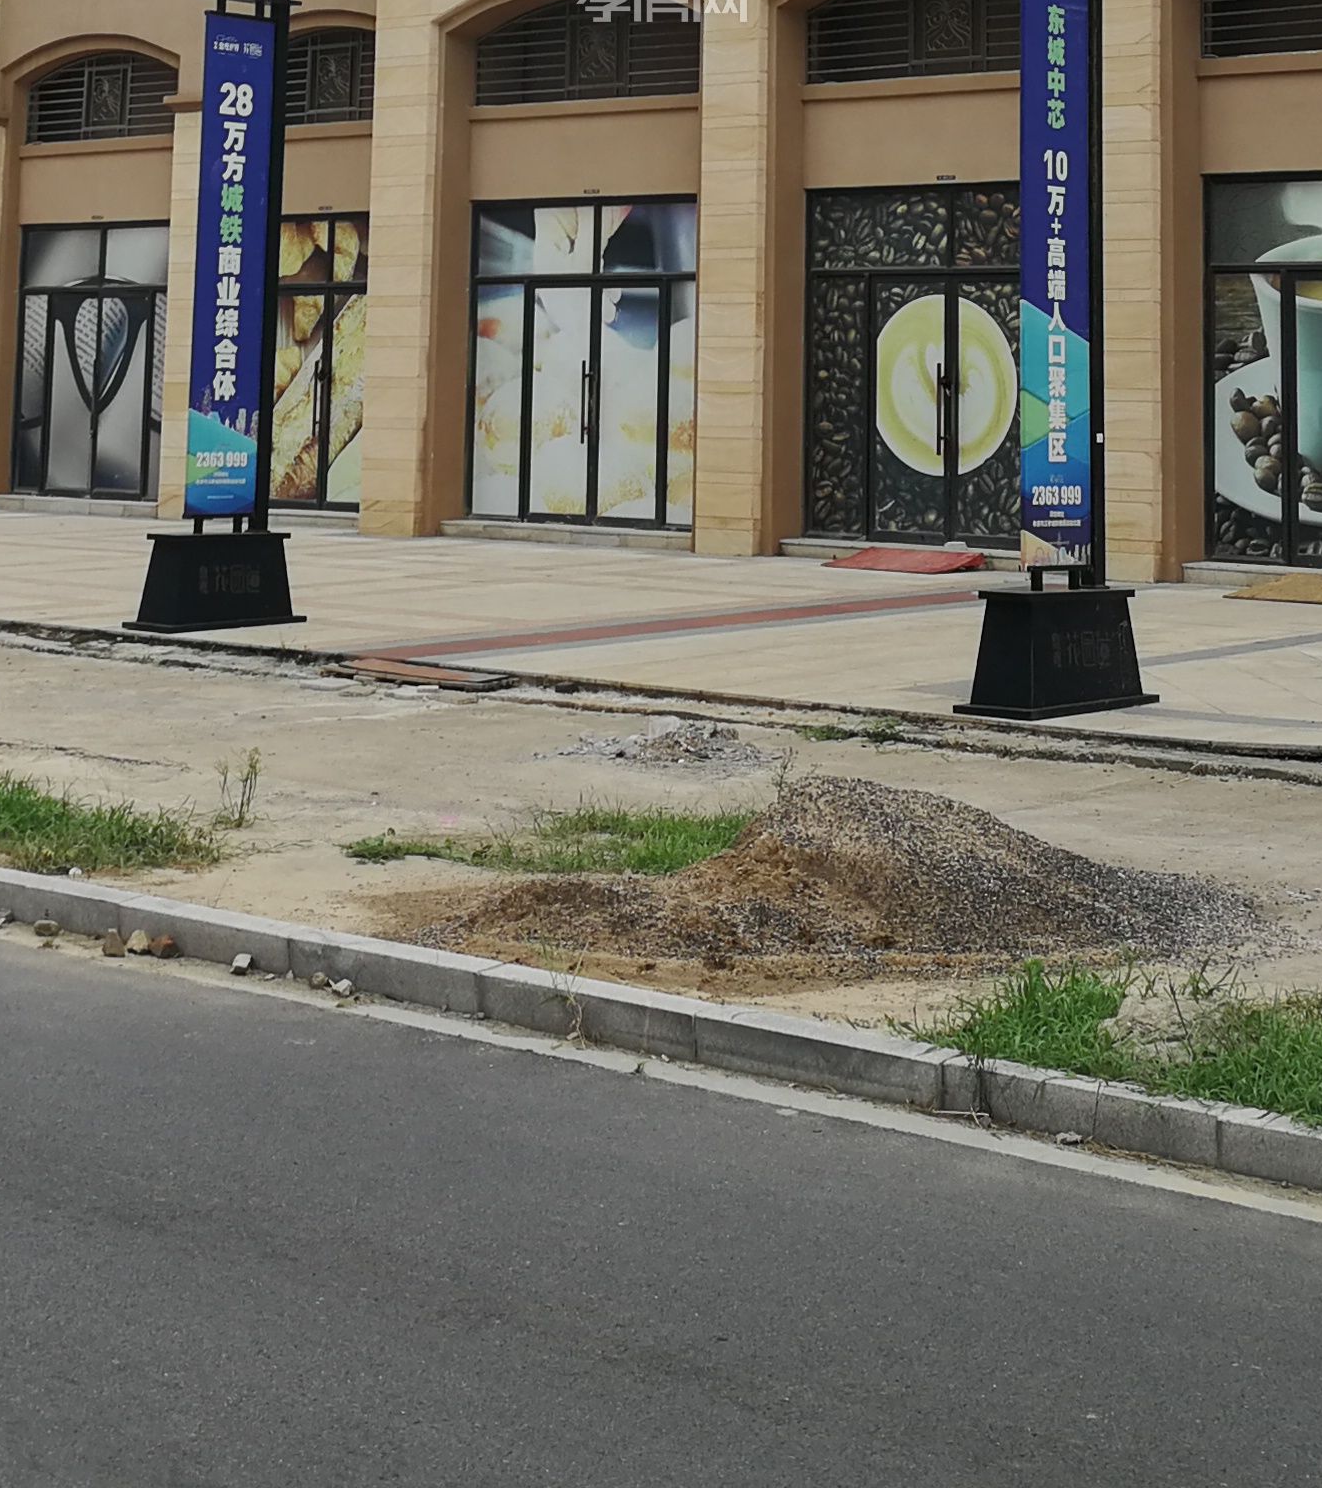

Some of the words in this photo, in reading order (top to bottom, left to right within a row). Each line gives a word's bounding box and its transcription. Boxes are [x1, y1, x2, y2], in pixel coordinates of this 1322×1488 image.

[1047, 3, 1066, 130] 东城中芯
[1032, 485, 1060, 506] 2363
[1060, 485, 1082, 506] 999
